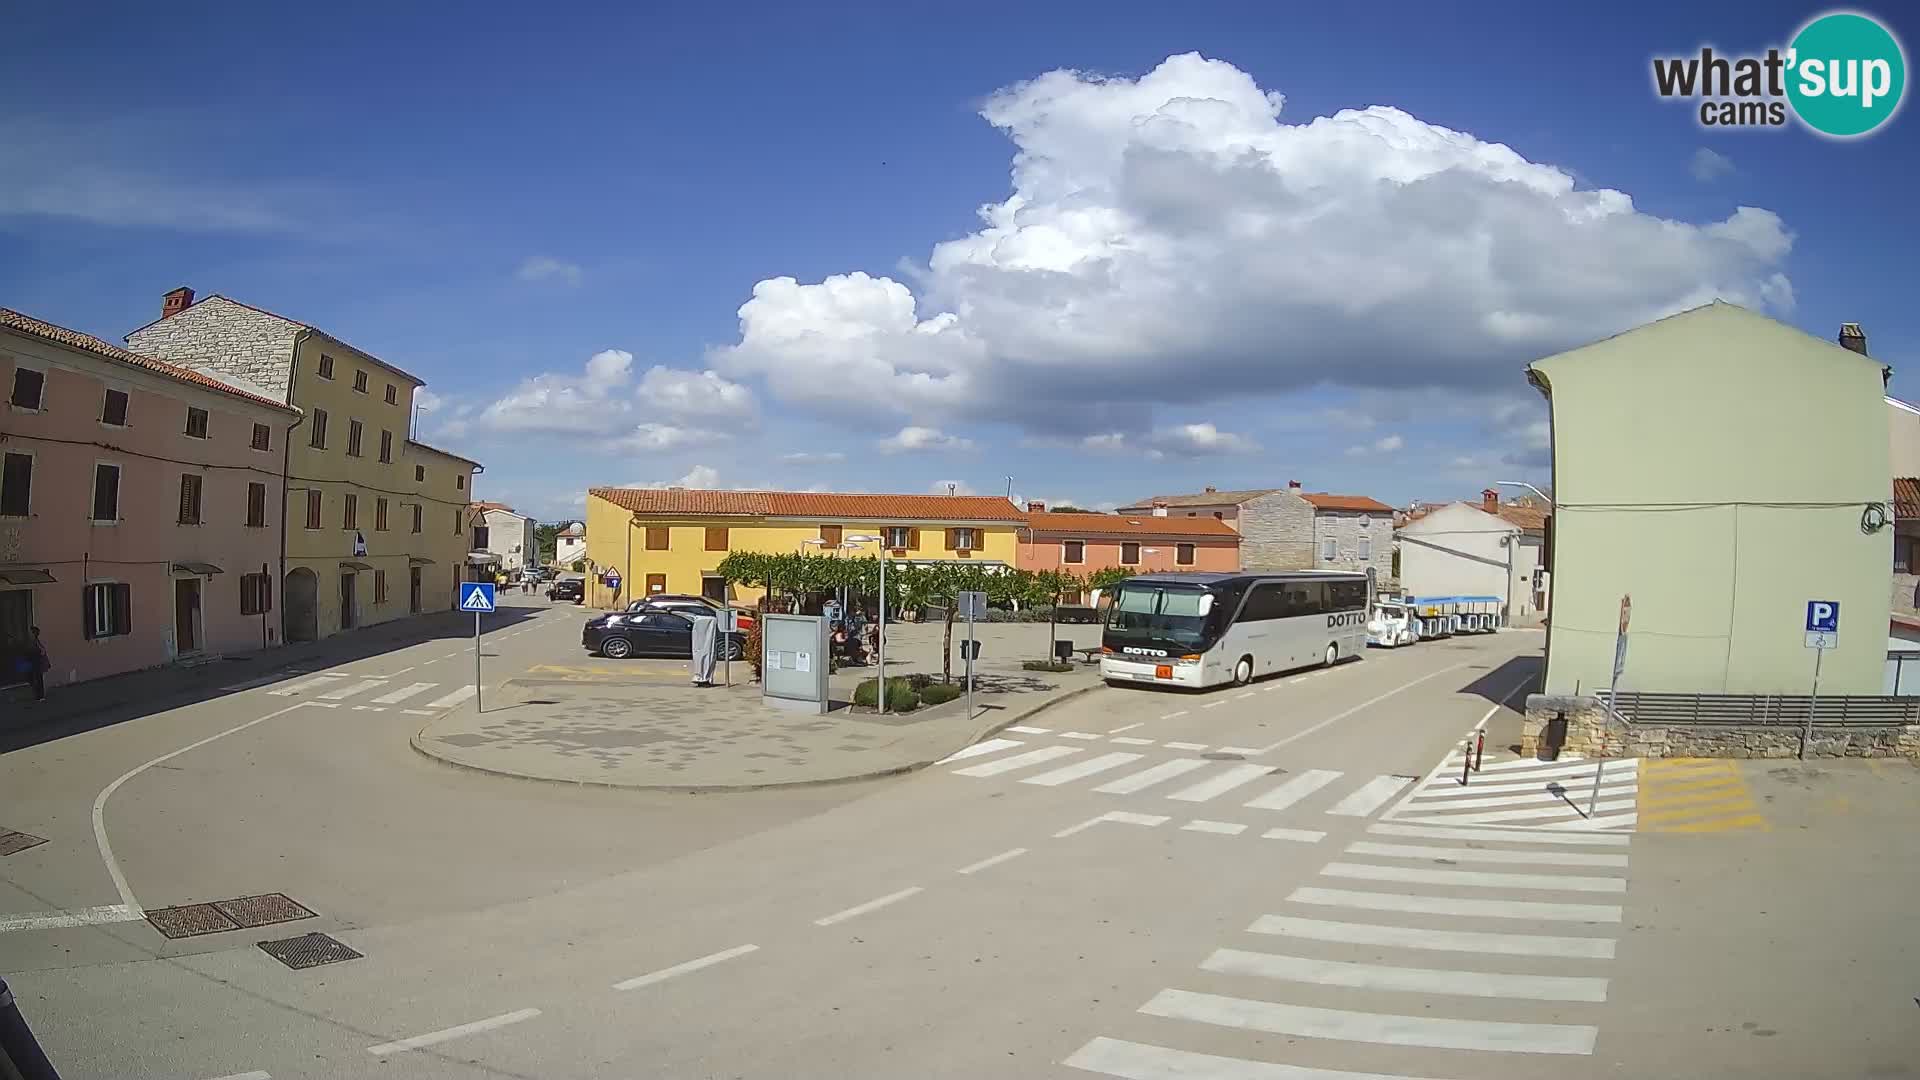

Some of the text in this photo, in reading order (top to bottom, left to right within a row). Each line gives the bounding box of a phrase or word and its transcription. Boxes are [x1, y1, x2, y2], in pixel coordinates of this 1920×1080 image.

[1327, 612, 1366, 628] DOTTO
[1812, 603, 1832, 626] P
[1123, 646, 1168, 657] DOTTO
